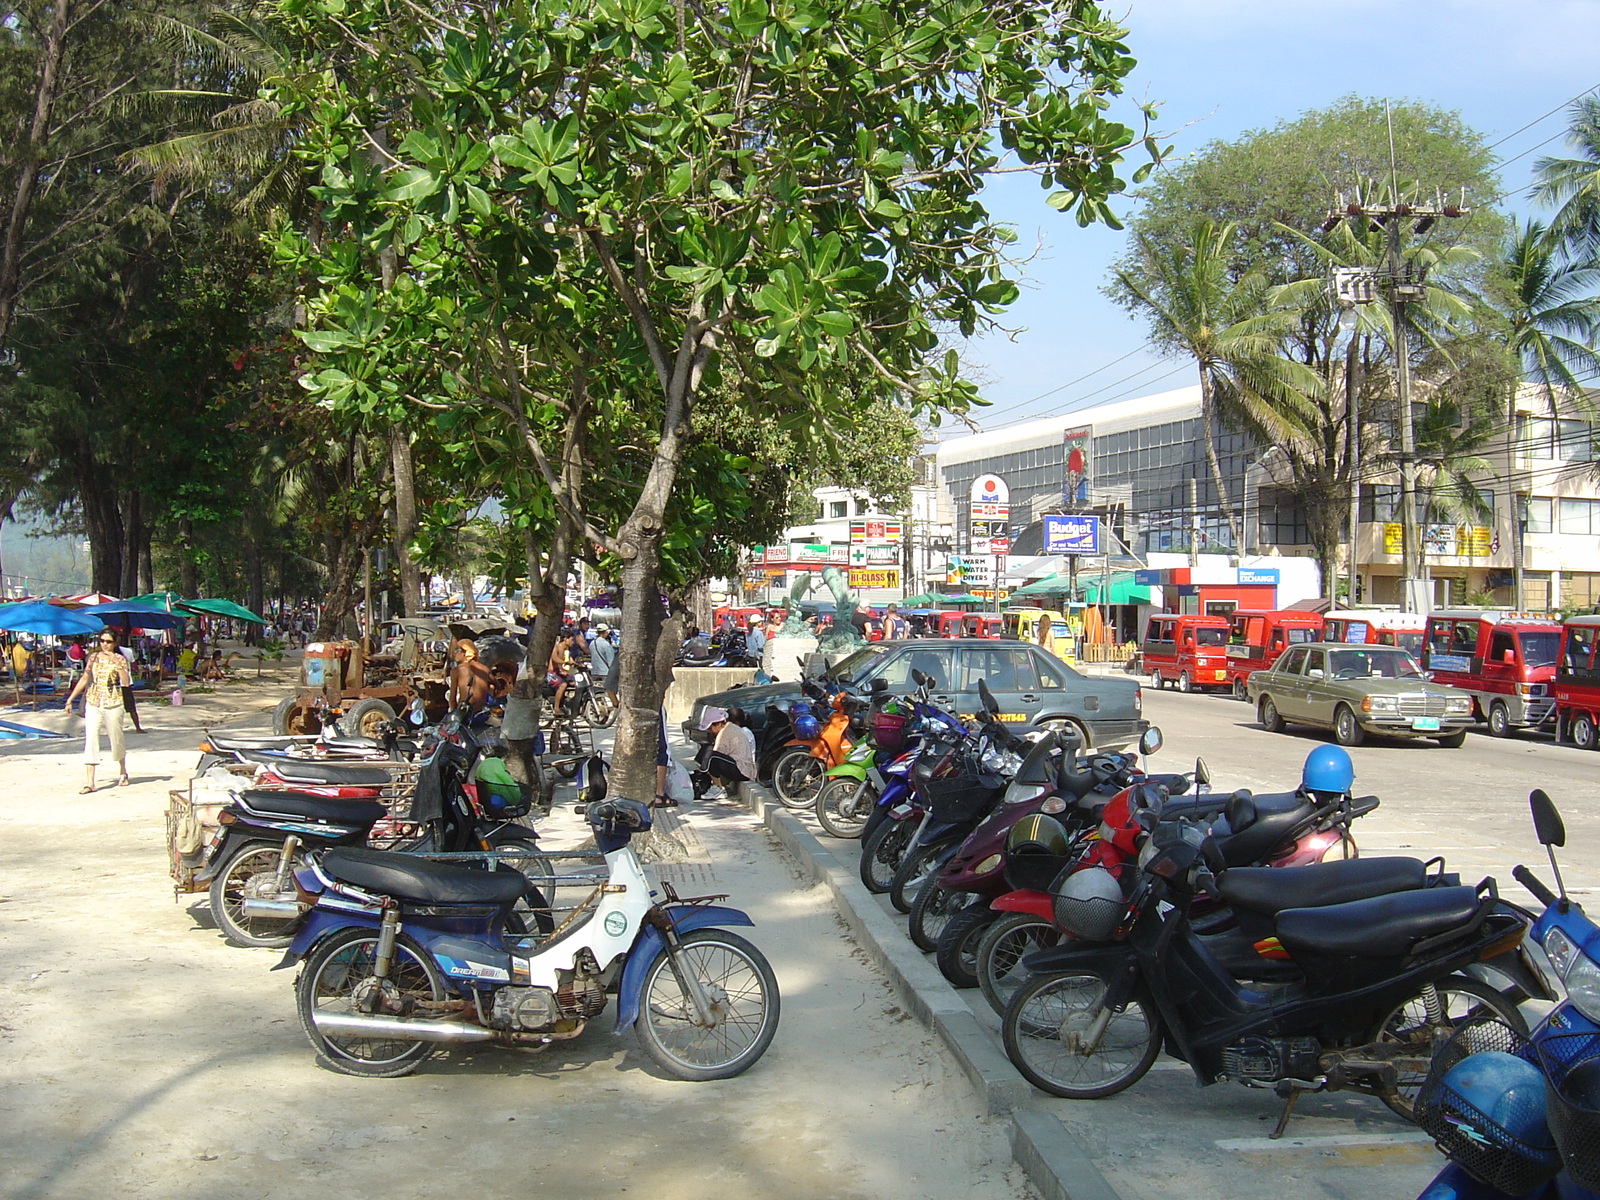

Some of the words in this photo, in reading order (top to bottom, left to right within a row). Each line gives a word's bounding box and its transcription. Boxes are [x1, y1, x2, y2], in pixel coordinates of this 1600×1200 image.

[1048, 521, 1093, 535] Budget
[767, 548, 786, 556] FRIEND
[850, 573, 885, 582] HI-CLASS
